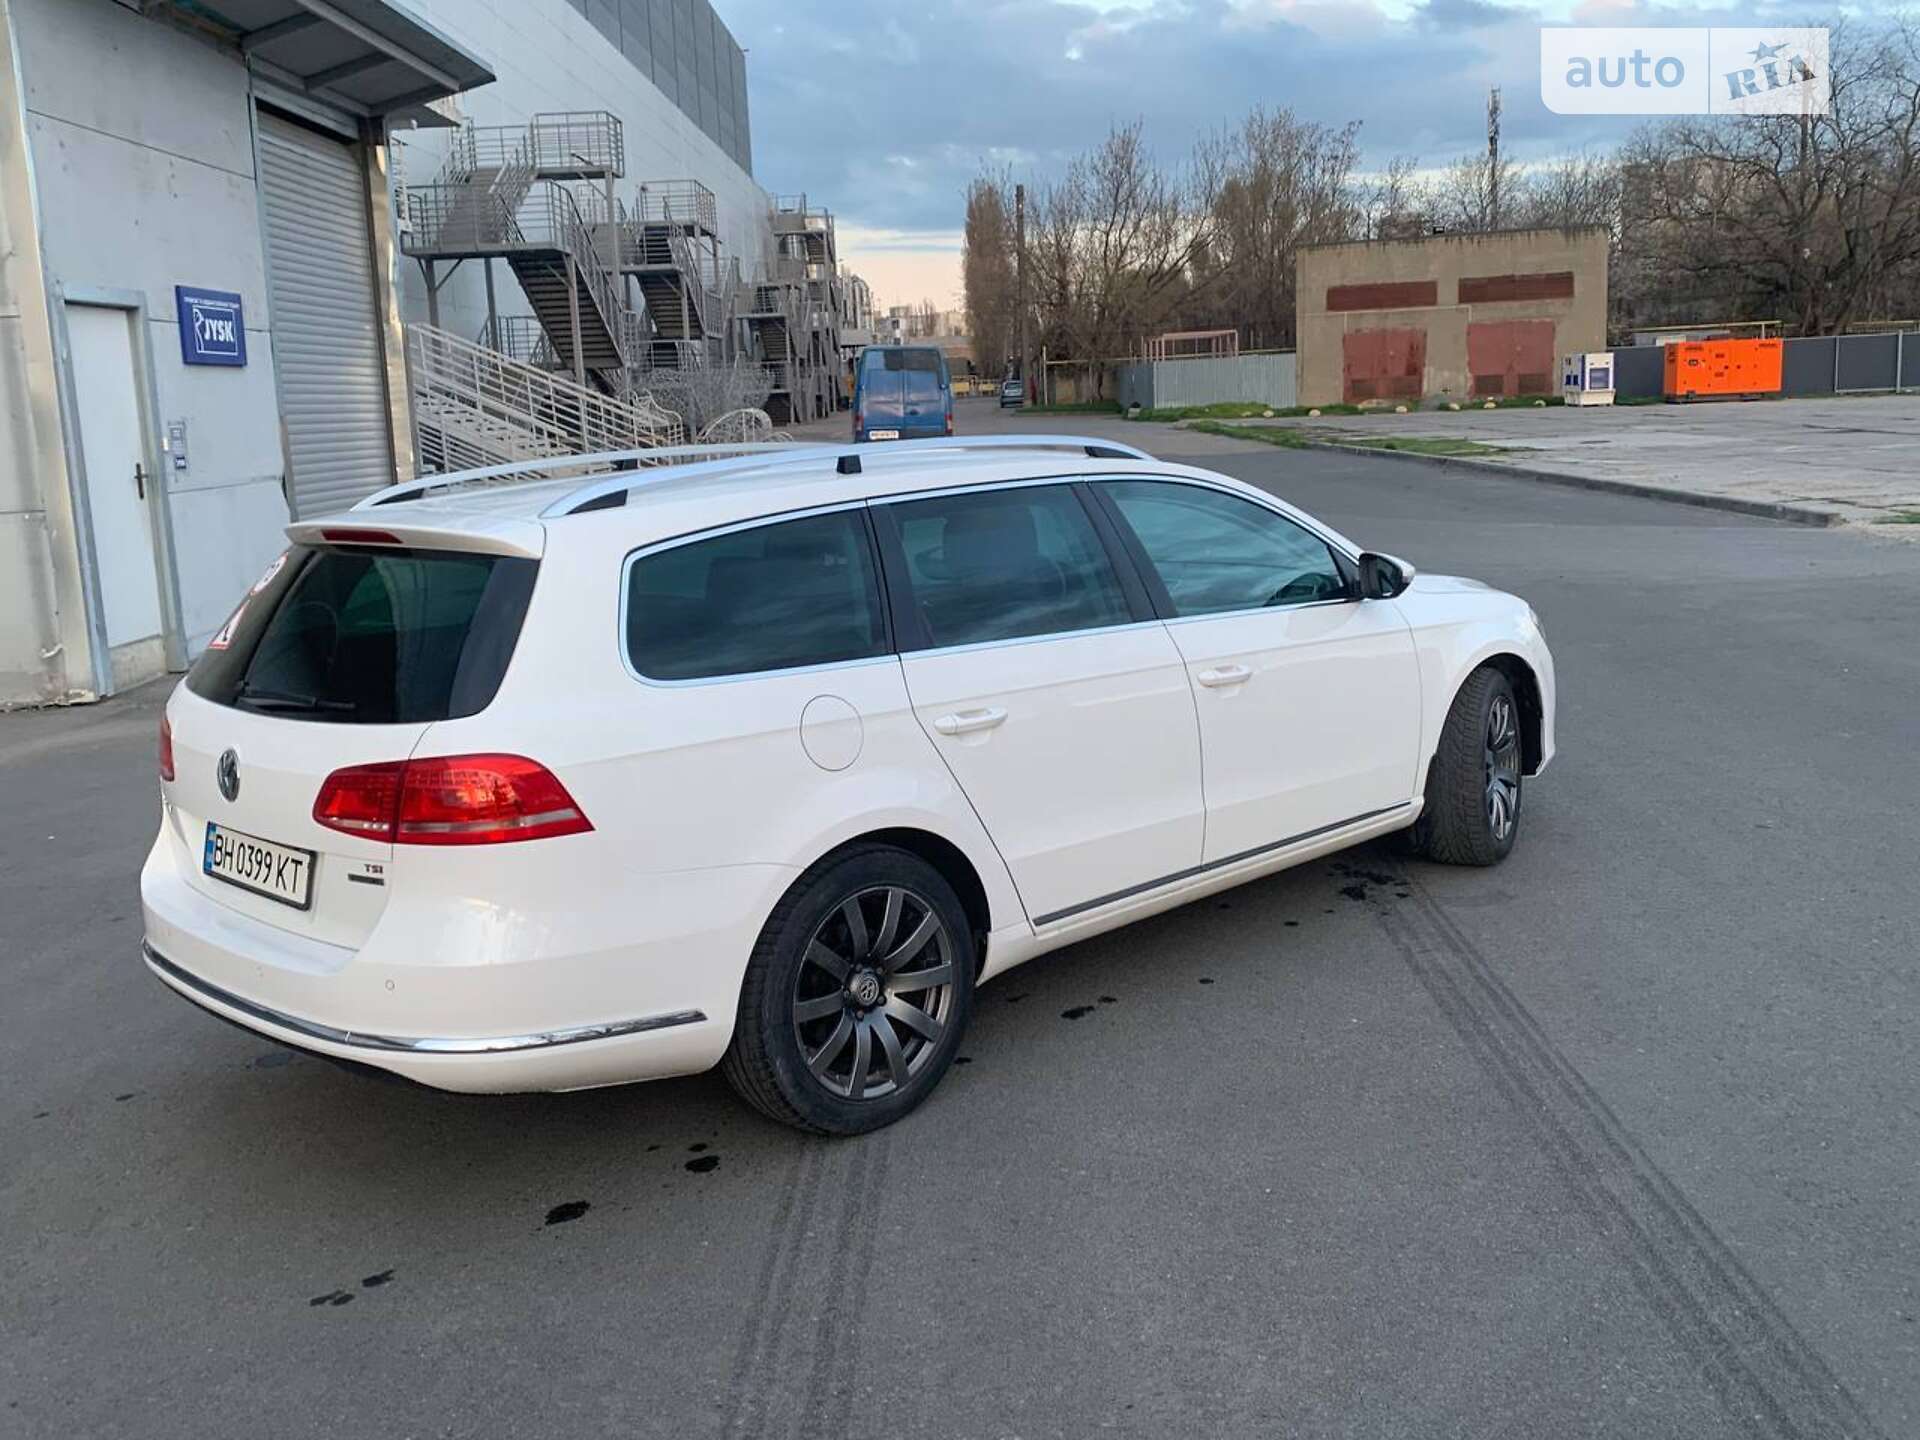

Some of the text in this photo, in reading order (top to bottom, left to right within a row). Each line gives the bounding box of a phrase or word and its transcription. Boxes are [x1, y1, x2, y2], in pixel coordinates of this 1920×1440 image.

[204, 318, 234, 342] JYSK
[214, 834, 304, 893] BH 0399 KT
